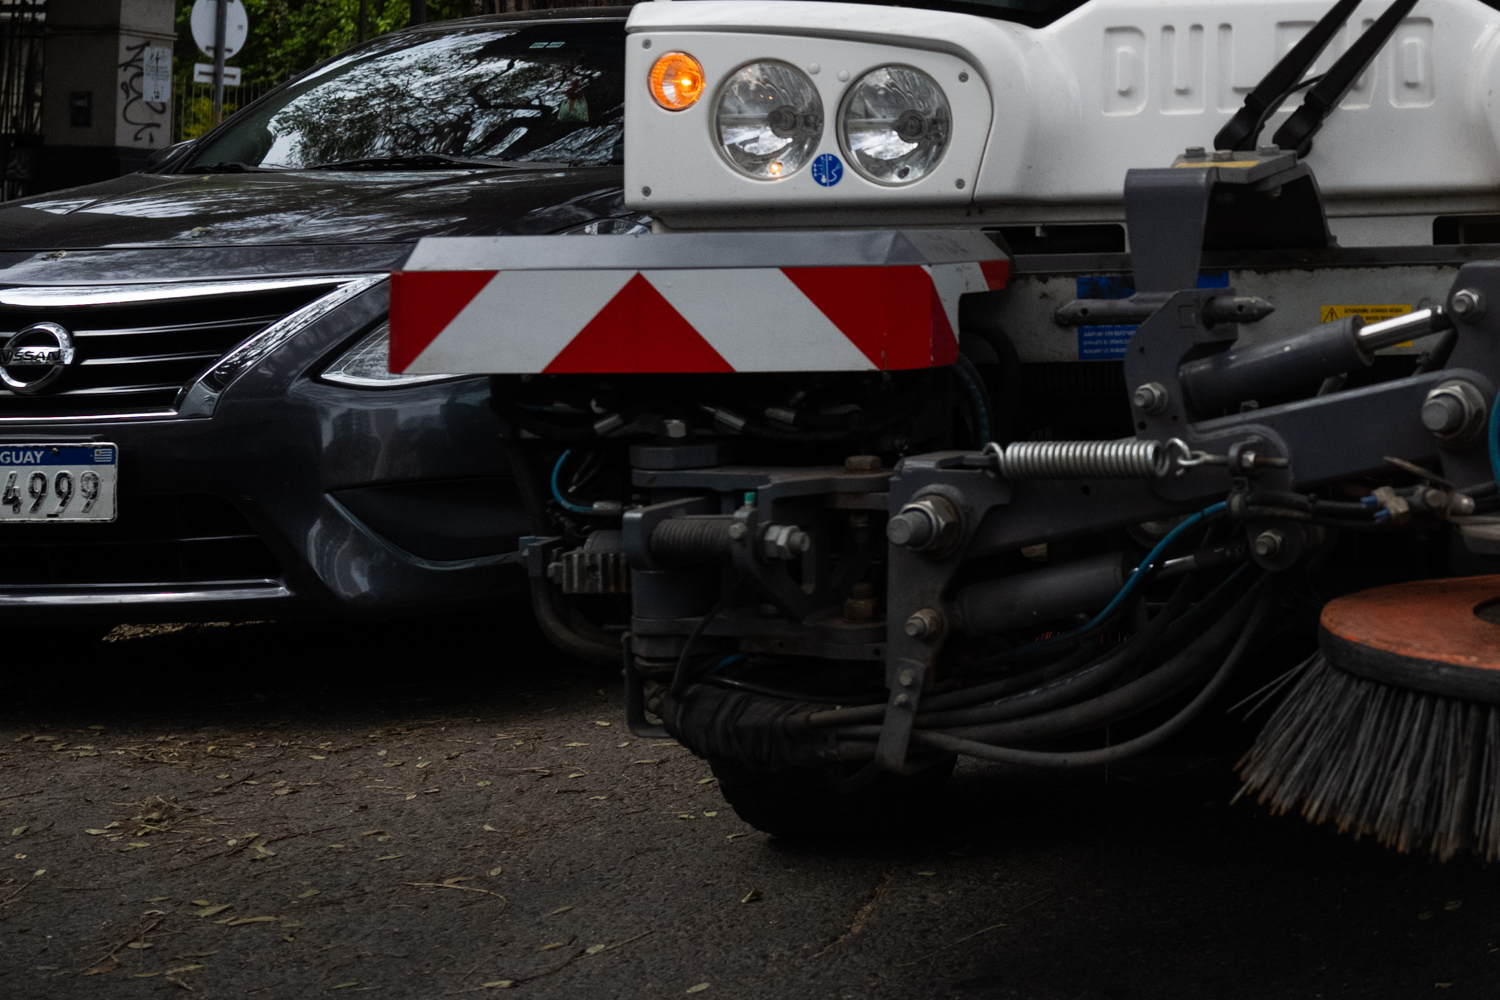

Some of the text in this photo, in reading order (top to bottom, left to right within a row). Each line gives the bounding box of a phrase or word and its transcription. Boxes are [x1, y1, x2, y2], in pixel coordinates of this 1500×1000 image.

[0, 351, 61, 364] NISSAN
[0, 450, 44, 464] GUAY
[2, 470, 101, 515] 4999
